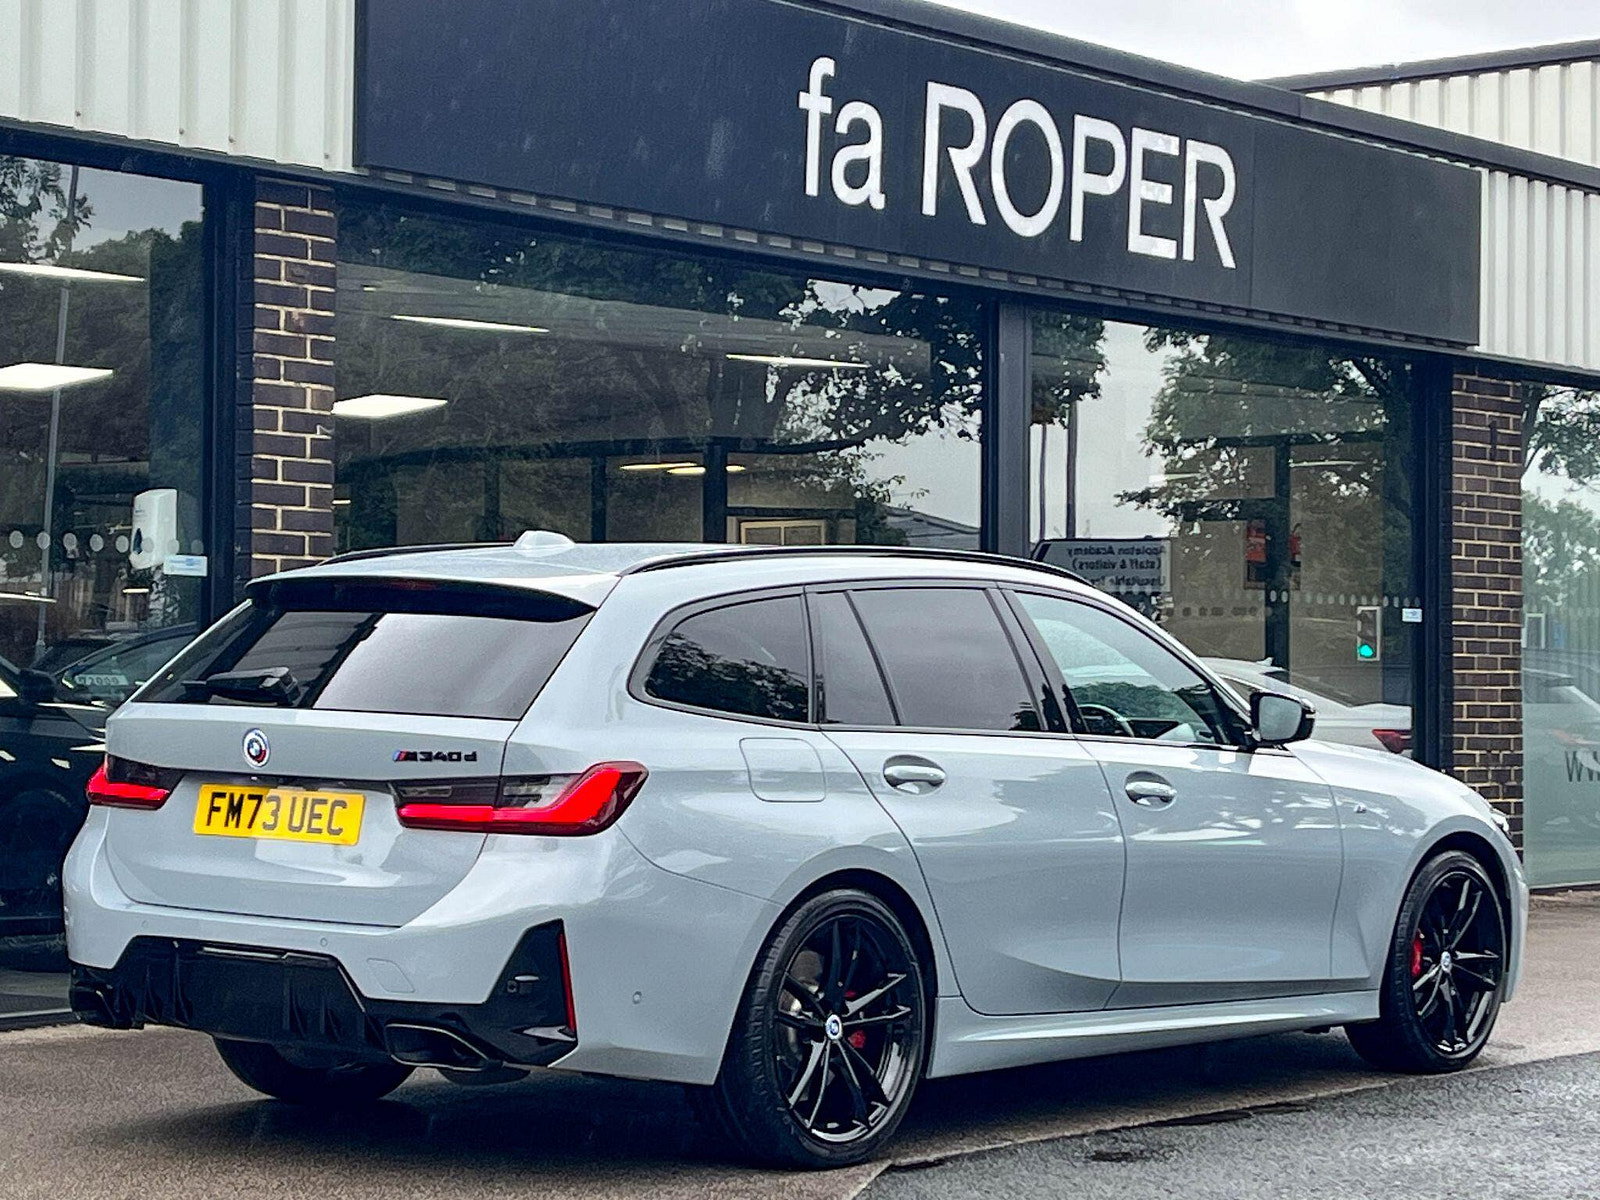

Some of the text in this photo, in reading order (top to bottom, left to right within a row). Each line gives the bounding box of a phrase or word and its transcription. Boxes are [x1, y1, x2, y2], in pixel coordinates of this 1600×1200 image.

[799, 56, 1236, 269] fa ROPER
[206, 792, 348, 836] FM73 UEC
